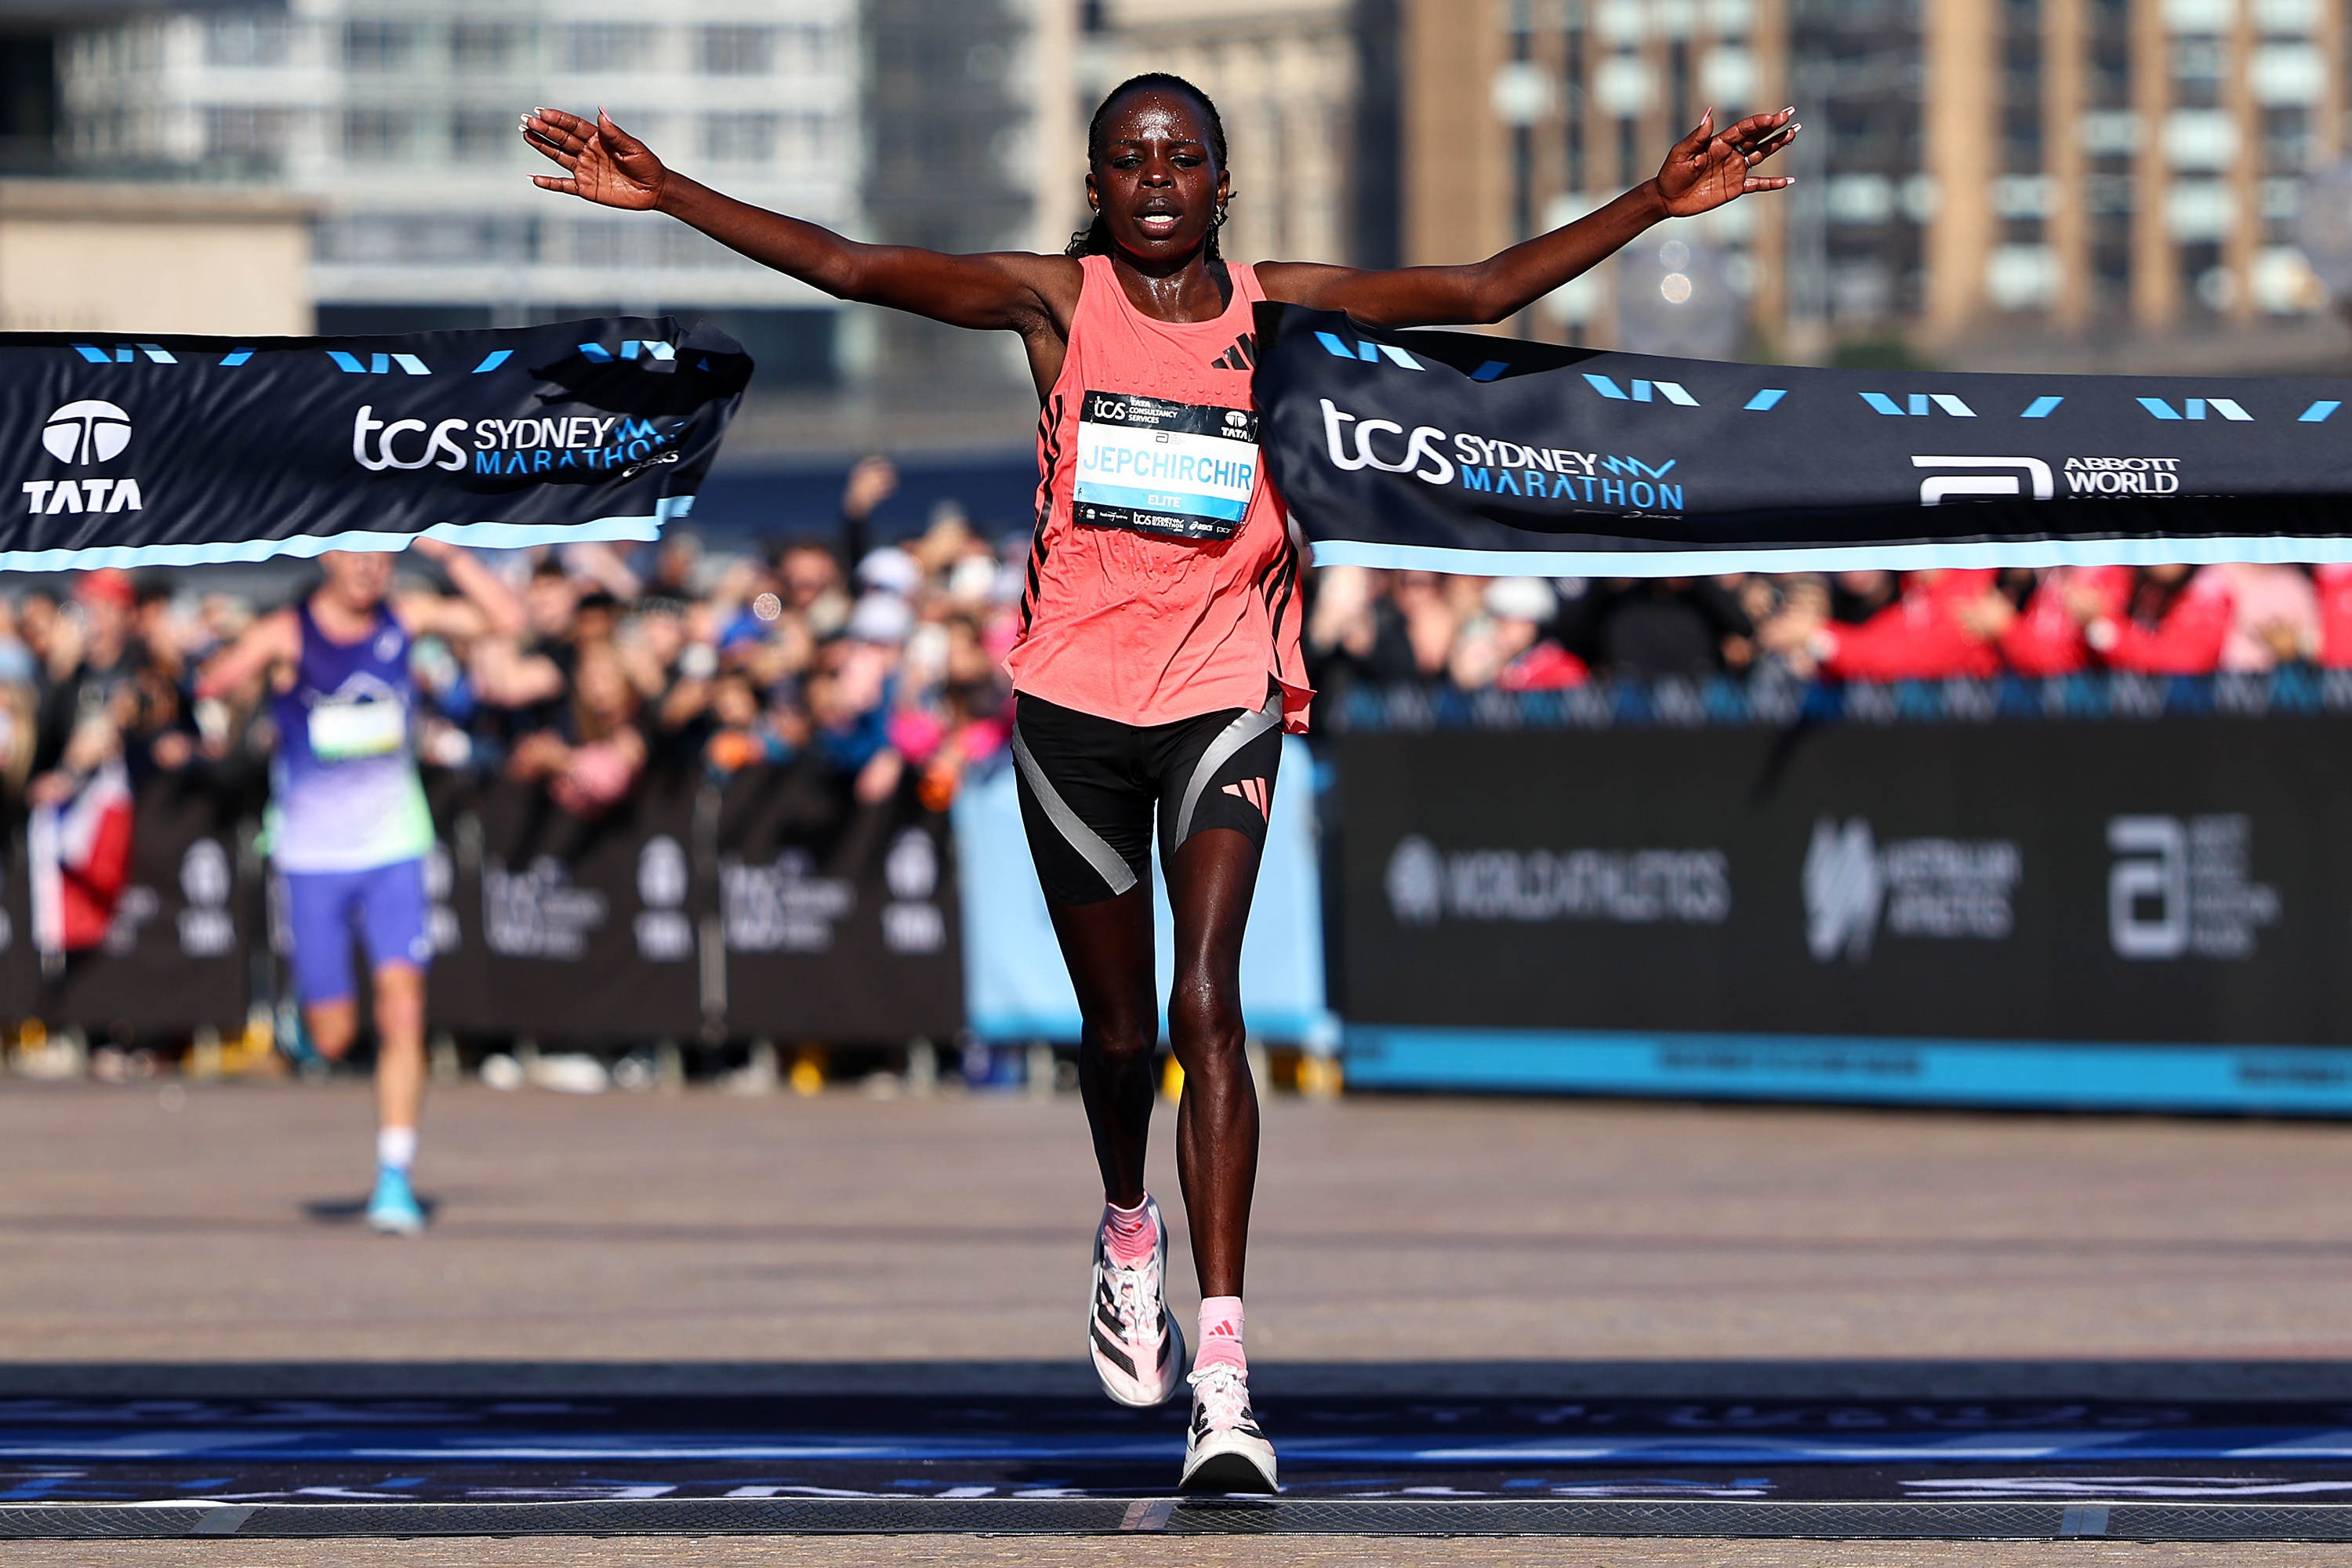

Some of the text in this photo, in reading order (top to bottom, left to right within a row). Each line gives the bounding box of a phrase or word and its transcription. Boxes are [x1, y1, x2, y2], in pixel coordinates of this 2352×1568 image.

[1094, 396, 1126, 419] tcs
[1129, 406, 1178, 418] CONSULTANCY
[1131, 399, 1151, 408] TATA
[1128, 414, 1160, 423] SERVICES
[352, 404, 467, 471] tcs
[474, 416, 615, 450] SYDNEY
[1221, 426, 1247, 440] TATA
[1319, 398, 1454, 485] tcs
[475, 433, 676, 474] MARATHO
[1083, 445, 1252, 490] JEPCHIRCHIR
[1454, 433, 1597, 476] SYDNEY
[2063, 457, 2180, 471] ABBOTT
[22, 478, 143, 514] TATA
[1461, 464, 1683, 510] MARATHON
[2063, 471, 2180, 494] WORLD
[1148, 494, 1181, 509] ELITE
